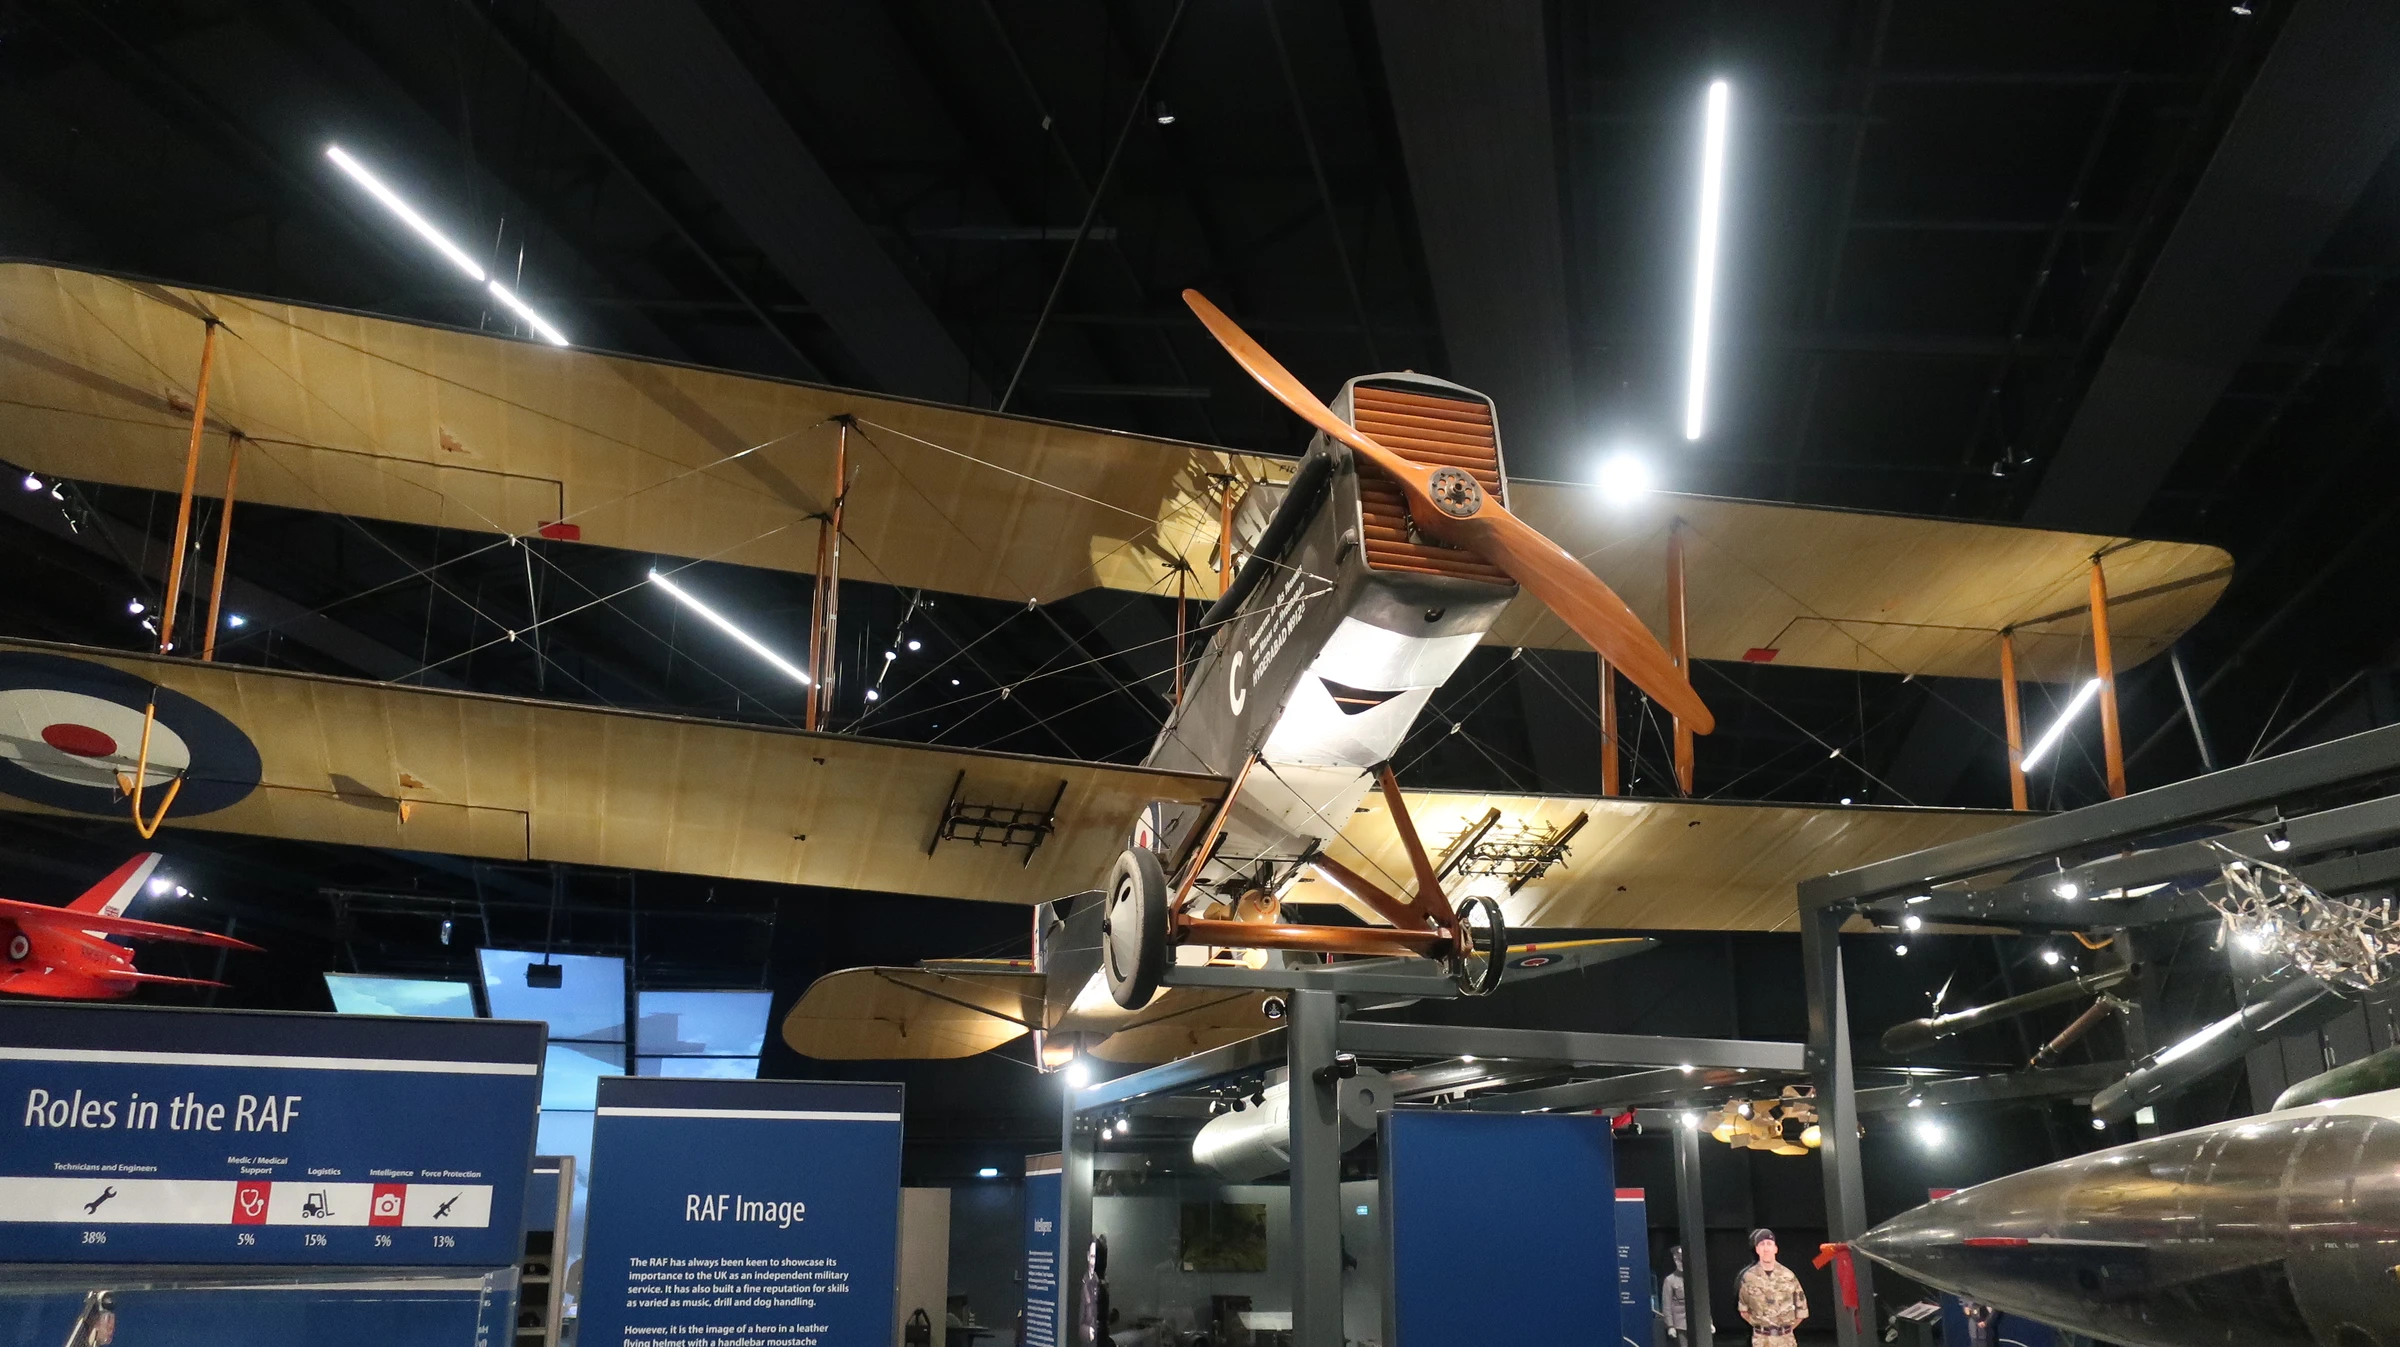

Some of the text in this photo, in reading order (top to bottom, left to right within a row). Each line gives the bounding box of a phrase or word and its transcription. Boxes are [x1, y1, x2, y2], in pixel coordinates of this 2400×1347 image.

[1252, 628, 1287, 687] HYDERABAD
[1229, 650, 1247, 717] C
[25, 1089, 301, 1132] Roles in the RAF
[119, 1164, 157, 1173] Engineers
[241, 1166, 272, 1175] Support
[308, 1168, 341, 1176] Logistics
[370, 1169, 414, 1178] Intelligence
[686, 1195, 805, 1228] RAF Image
[82, 1232, 106, 1243] 38%
[238, 1234, 254, 1245] 5%
[305, 1234, 326, 1246] 15%
[375, 1235, 391, 1246] 5%
[434, 1236, 454, 1247] 13%
[630, 1258, 647, 1266] The
[650, 1258, 668, 1266] RAF
[670, 1258, 686, 1266] has
[688, 1258, 718, 1268] always
[721, 1258, 743, 1266] been
[746, 1258, 767, 1266] keen
[782, 1258, 824, 1266] showcase
[826, 1258, 836, 1266] its
[629, 1272, 682, 1282] importance
[697, 1271, 712, 1279] the
[714, 1271, 727, 1279] UK
[755, 1271, 812, 1281] independent
[815, 1271, 848, 1281] military
[628, 1285, 663, 1293] service.
[665, 1285, 671, 1293] It
[674, 1285, 689, 1293] has
[692, 1284, 710, 1293] also
[713, 1284, 734, 1293] built
[744, 1284, 761, 1293] fine
[763, 1284, 810, 1294] reputation
[813, 1284, 825, 1292] for
[828, 1284, 849, 1292] skills
[639, 1298, 668, 1307] varied
[683, 1298, 711, 1307] music,
[714, 1298, 732, 1306] drill
[734, 1298, 751, 1306] and
[754, 1297, 771, 1308] dog
[774, 1297, 816, 1308] handling.
[625, 1326, 668, 1335] However,
[670, 1326, 677, 1334] it
[679, 1325, 686, 1333] is
[689, 1325, 703, 1334] the
[706, 1325, 734, 1335] image
[737, 1324, 746, 1333] of
[756, 1324, 776, 1333] hero
[779, 1324, 787, 1332] in
[797, 1324, 828, 1332] leather
[624, 1339, 650, 1347] flying
[653, 1339, 685, 1347] helmet
[688, 1338, 708, 1347] with
[718, 1338, 765, 1346] handlebar
[767, 1337, 817, 1346] moustache
